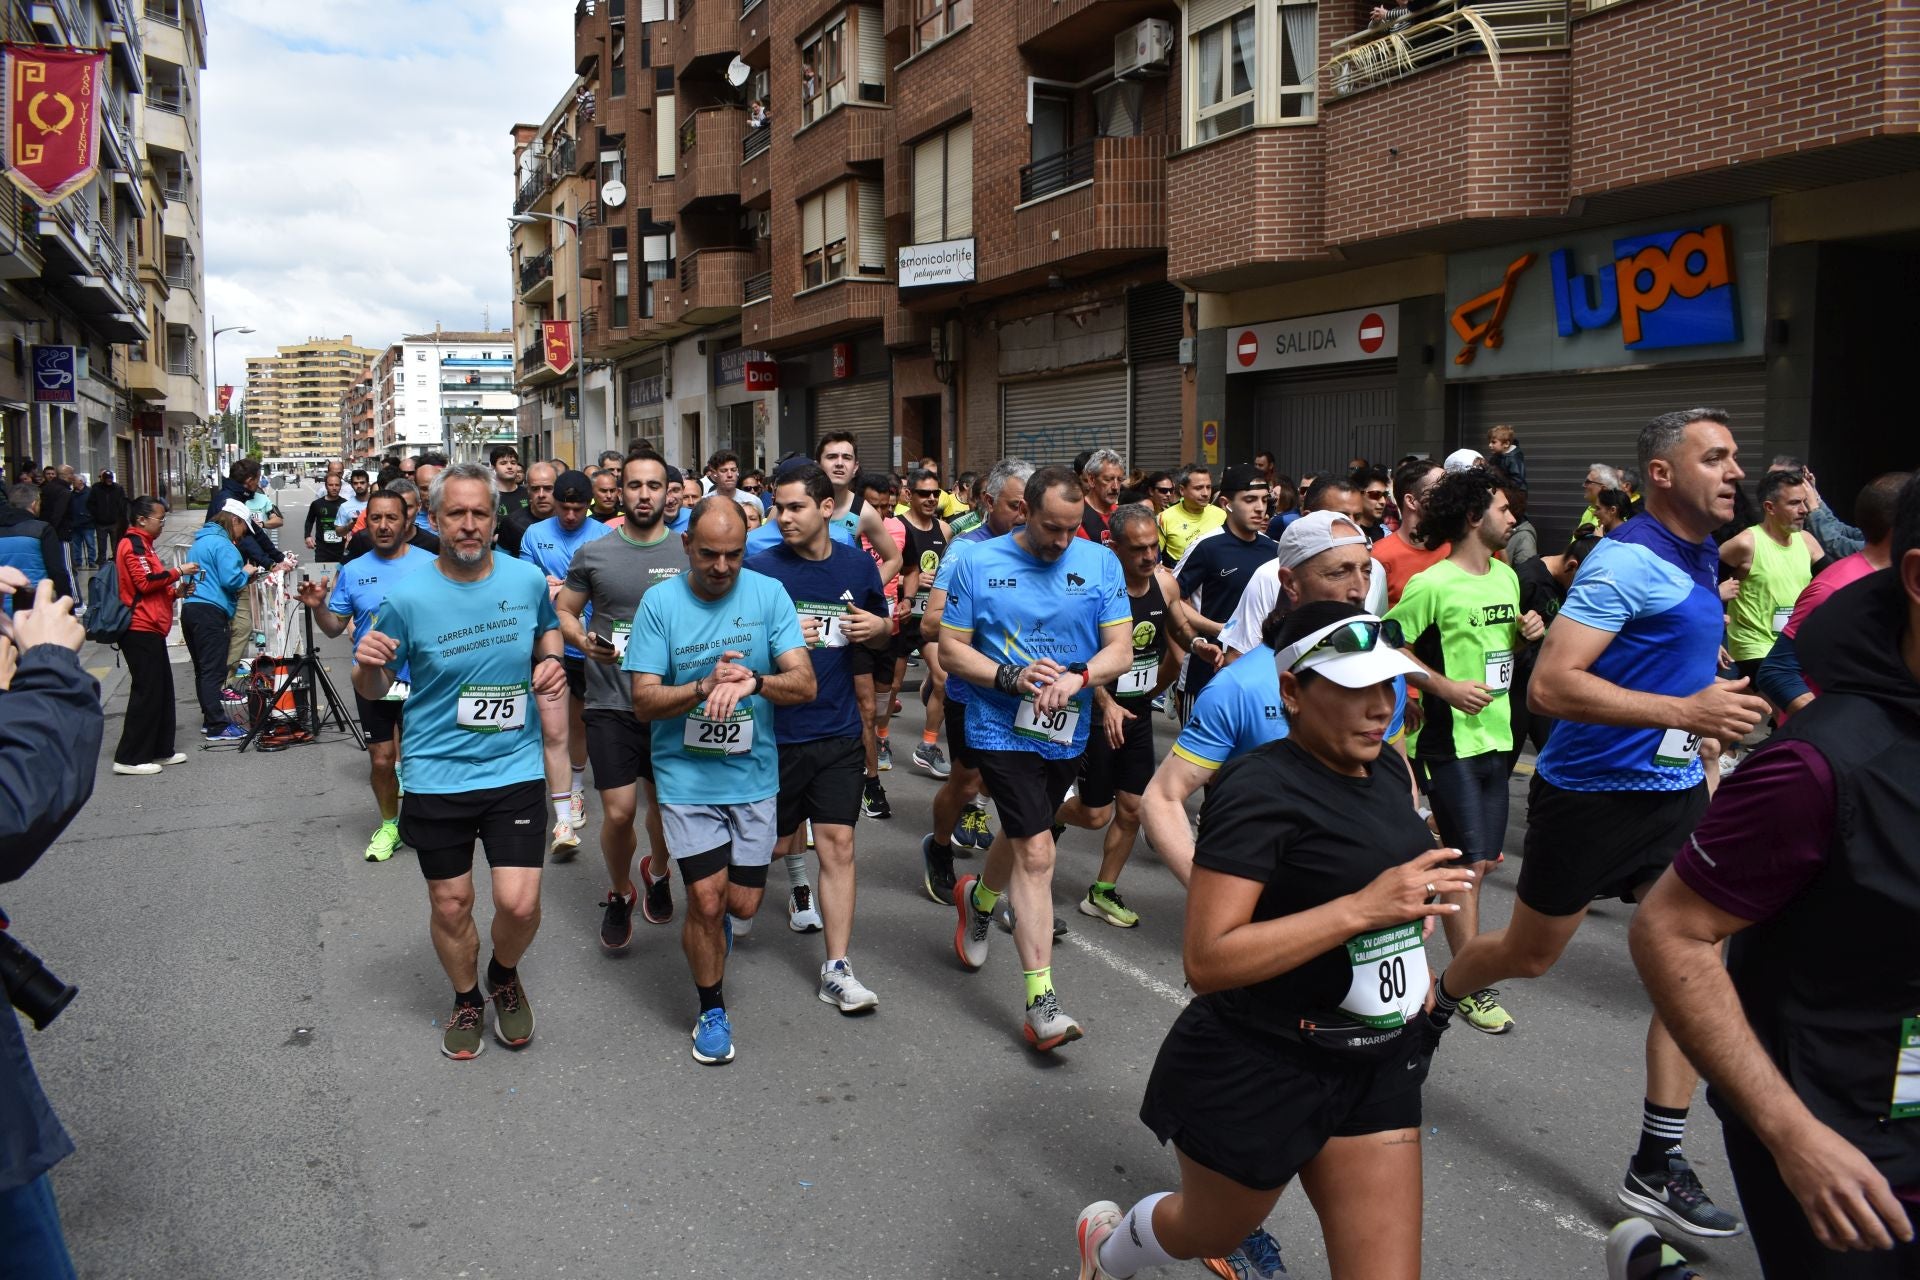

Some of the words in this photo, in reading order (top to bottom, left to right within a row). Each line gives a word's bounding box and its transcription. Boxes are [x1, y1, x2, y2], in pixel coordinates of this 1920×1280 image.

[81, 65, 91, 96] PASO
[78, 102, 89, 165] VIVIENTE
[1550, 224, 1731, 345] lupa
[1276, 328, 1337, 355] SALIDA
[437, 627, 474, 645] CARRERA
[474, 623, 486, 634] DE
[486, 617, 519, 631] NAVIDAD
[490, 637, 495, 646] Y
[675, 643, 710, 656] CARRERA
[710, 639, 721, 649] DE
[721, 633, 752, 647] NAVIDAD
[1133, 669, 1149, 688] 11
[473, 698, 515, 720] 275
[698, 722, 741, 744] 292
[1362, 939, 1373, 949] XV
[1373, 932, 1395, 947] CARRERA
[1394, 926, 1416, 940] POPULAR
[1378, 955, 1407, 1004] 80
[1361, 1027, 1403, 1046] KARRIMOR
